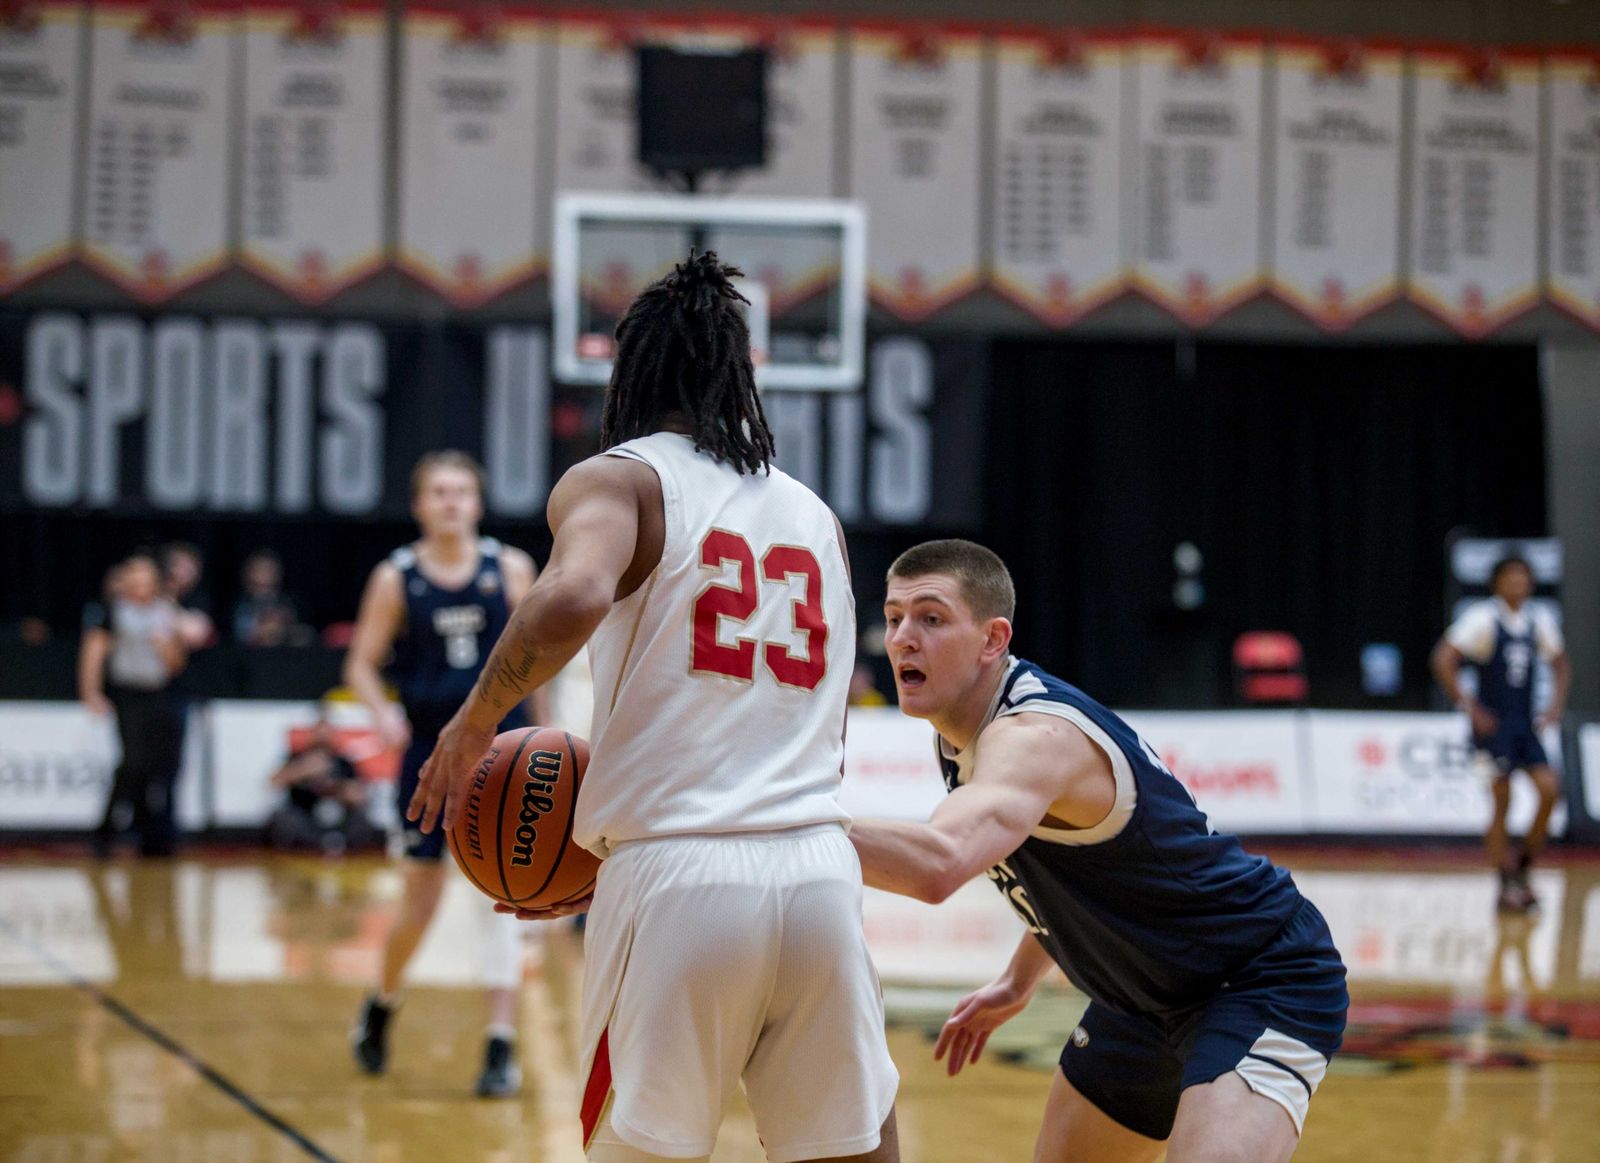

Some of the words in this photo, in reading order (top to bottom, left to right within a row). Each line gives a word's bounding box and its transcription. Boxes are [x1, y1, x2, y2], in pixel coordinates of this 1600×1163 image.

[24, 312, 387, 513] SPORTS
[485, 323, 549, 520] U
[688, 526, 831, 694] 23
[510, 749, 564, 868] Wilson
